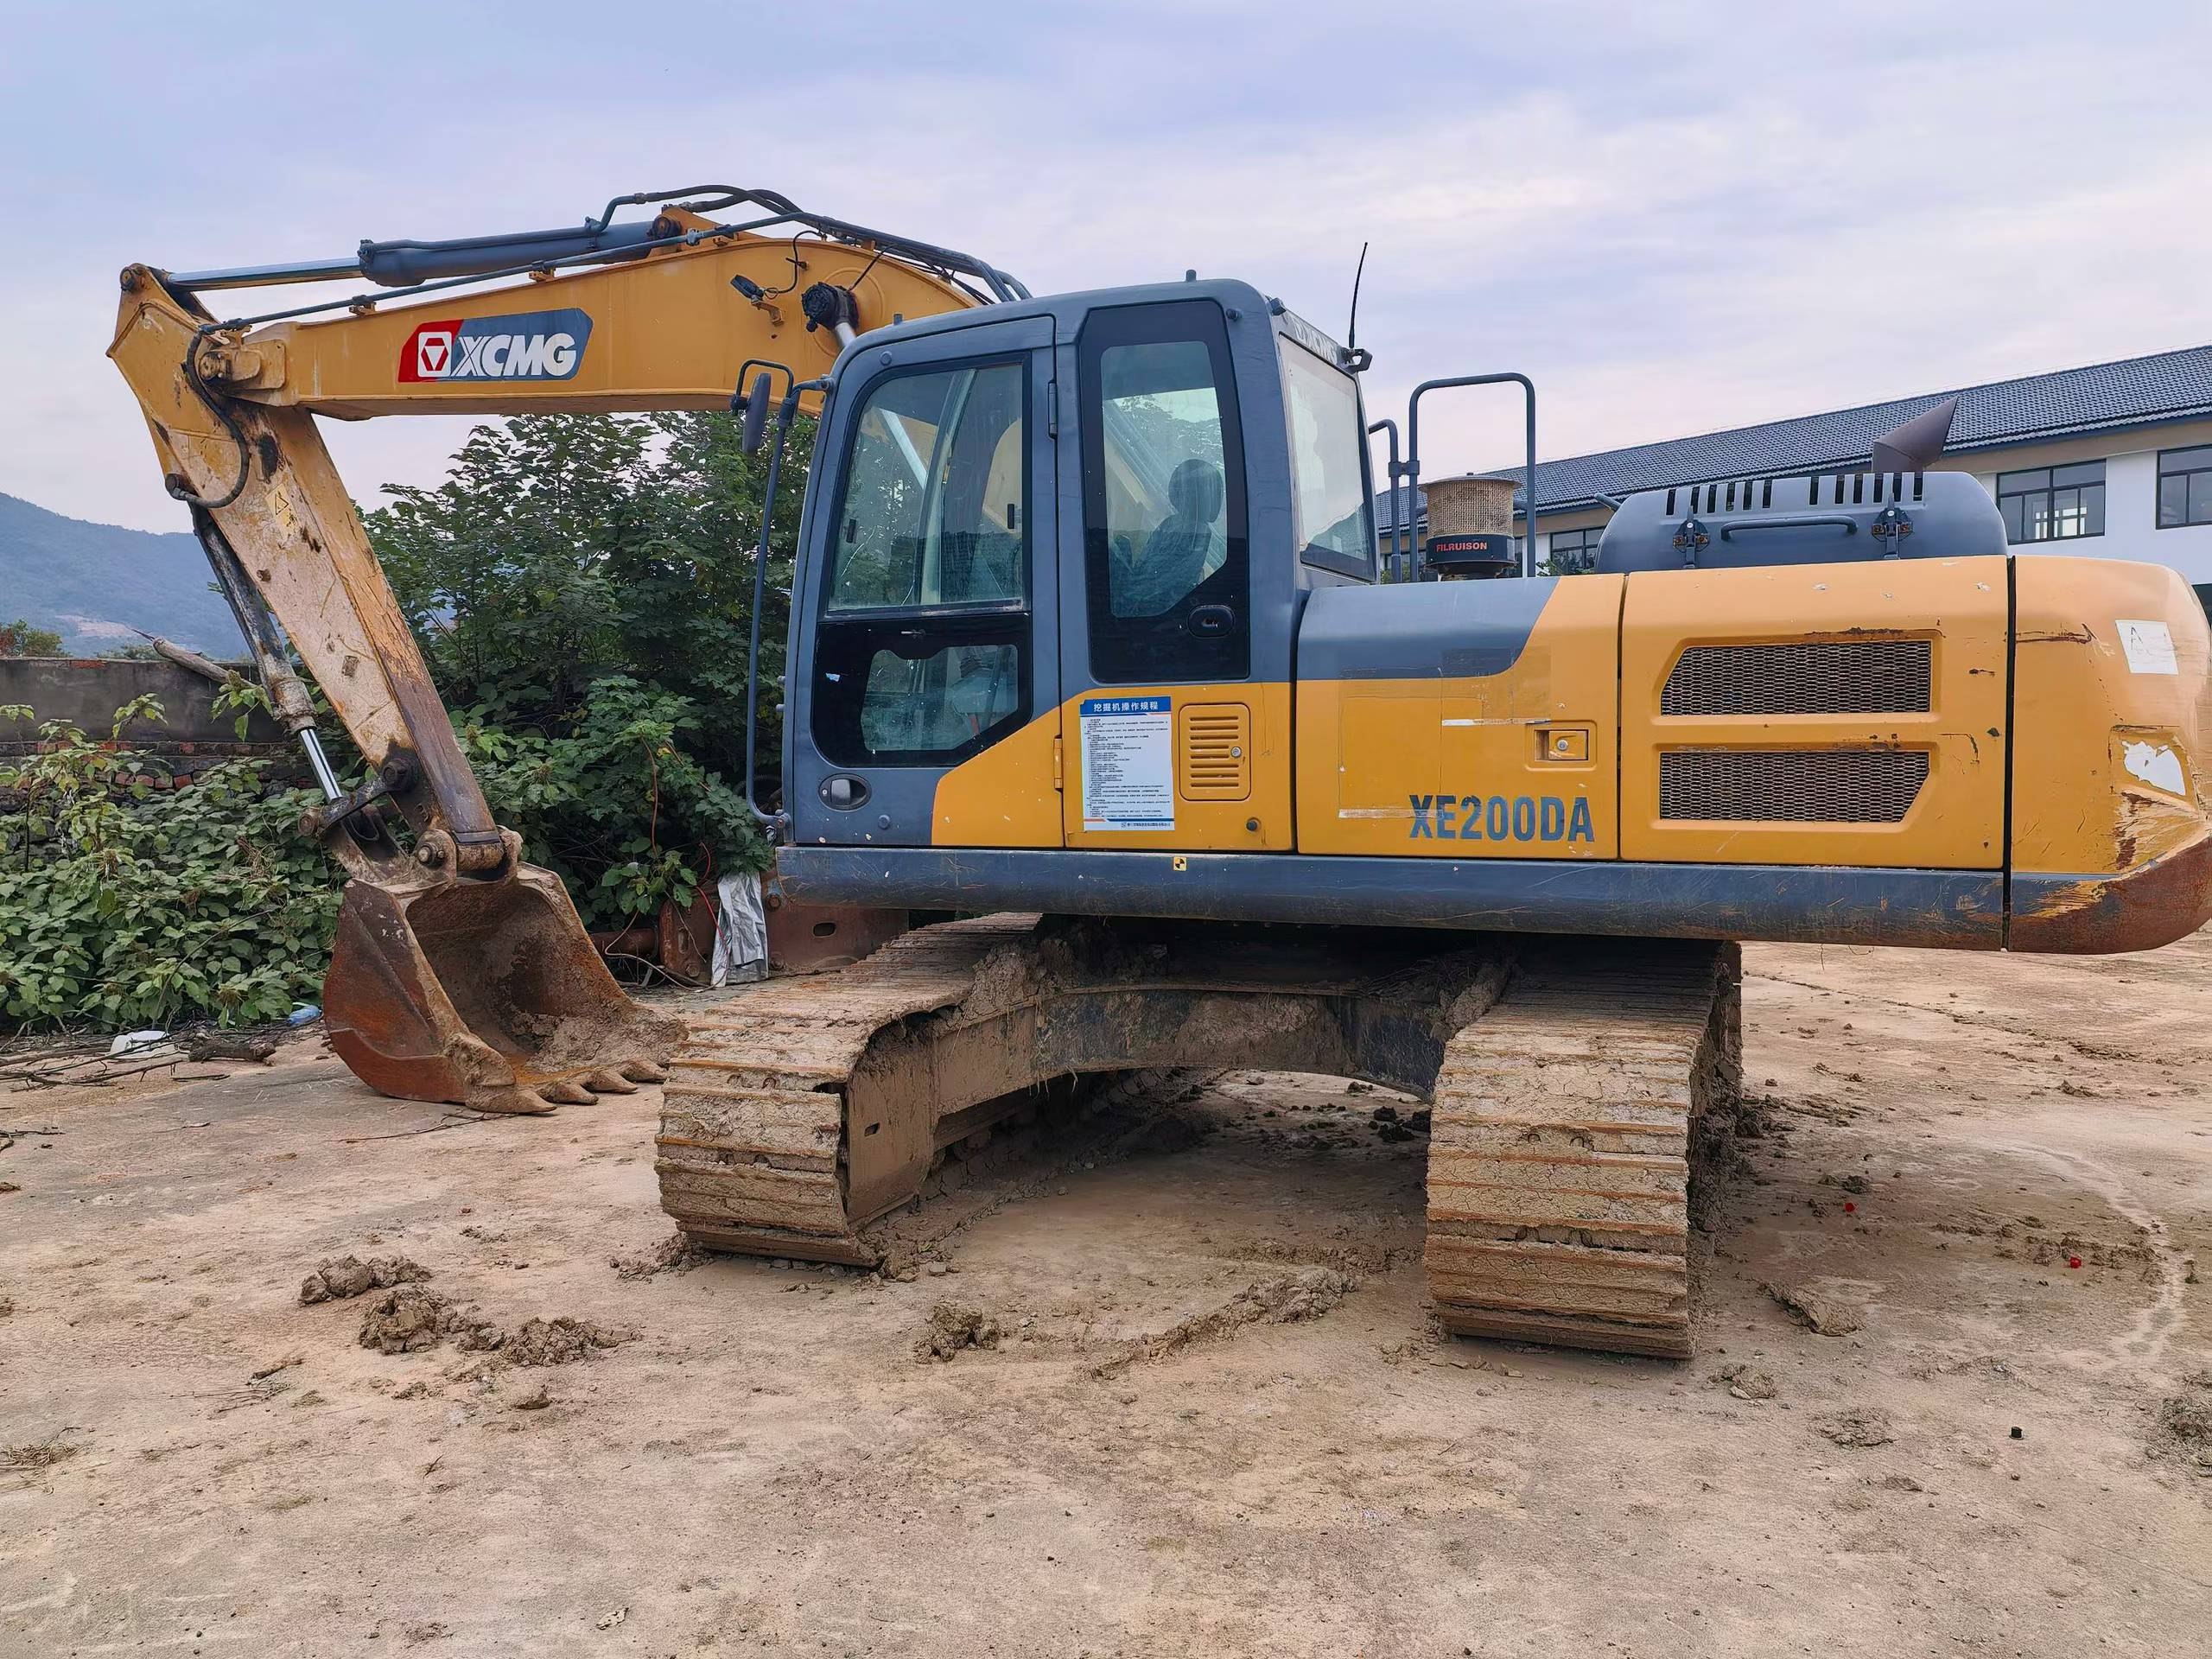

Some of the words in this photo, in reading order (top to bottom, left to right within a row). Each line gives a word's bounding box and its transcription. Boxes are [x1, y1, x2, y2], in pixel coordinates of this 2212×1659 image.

[450, 333, 576, 377] XCMG
[1436, 542, 1487, 552] FILRUISON
[1093, 701, 1159, 712] 挖掘机操作规程
[1409, 794, 1595, 842] XE200DA
